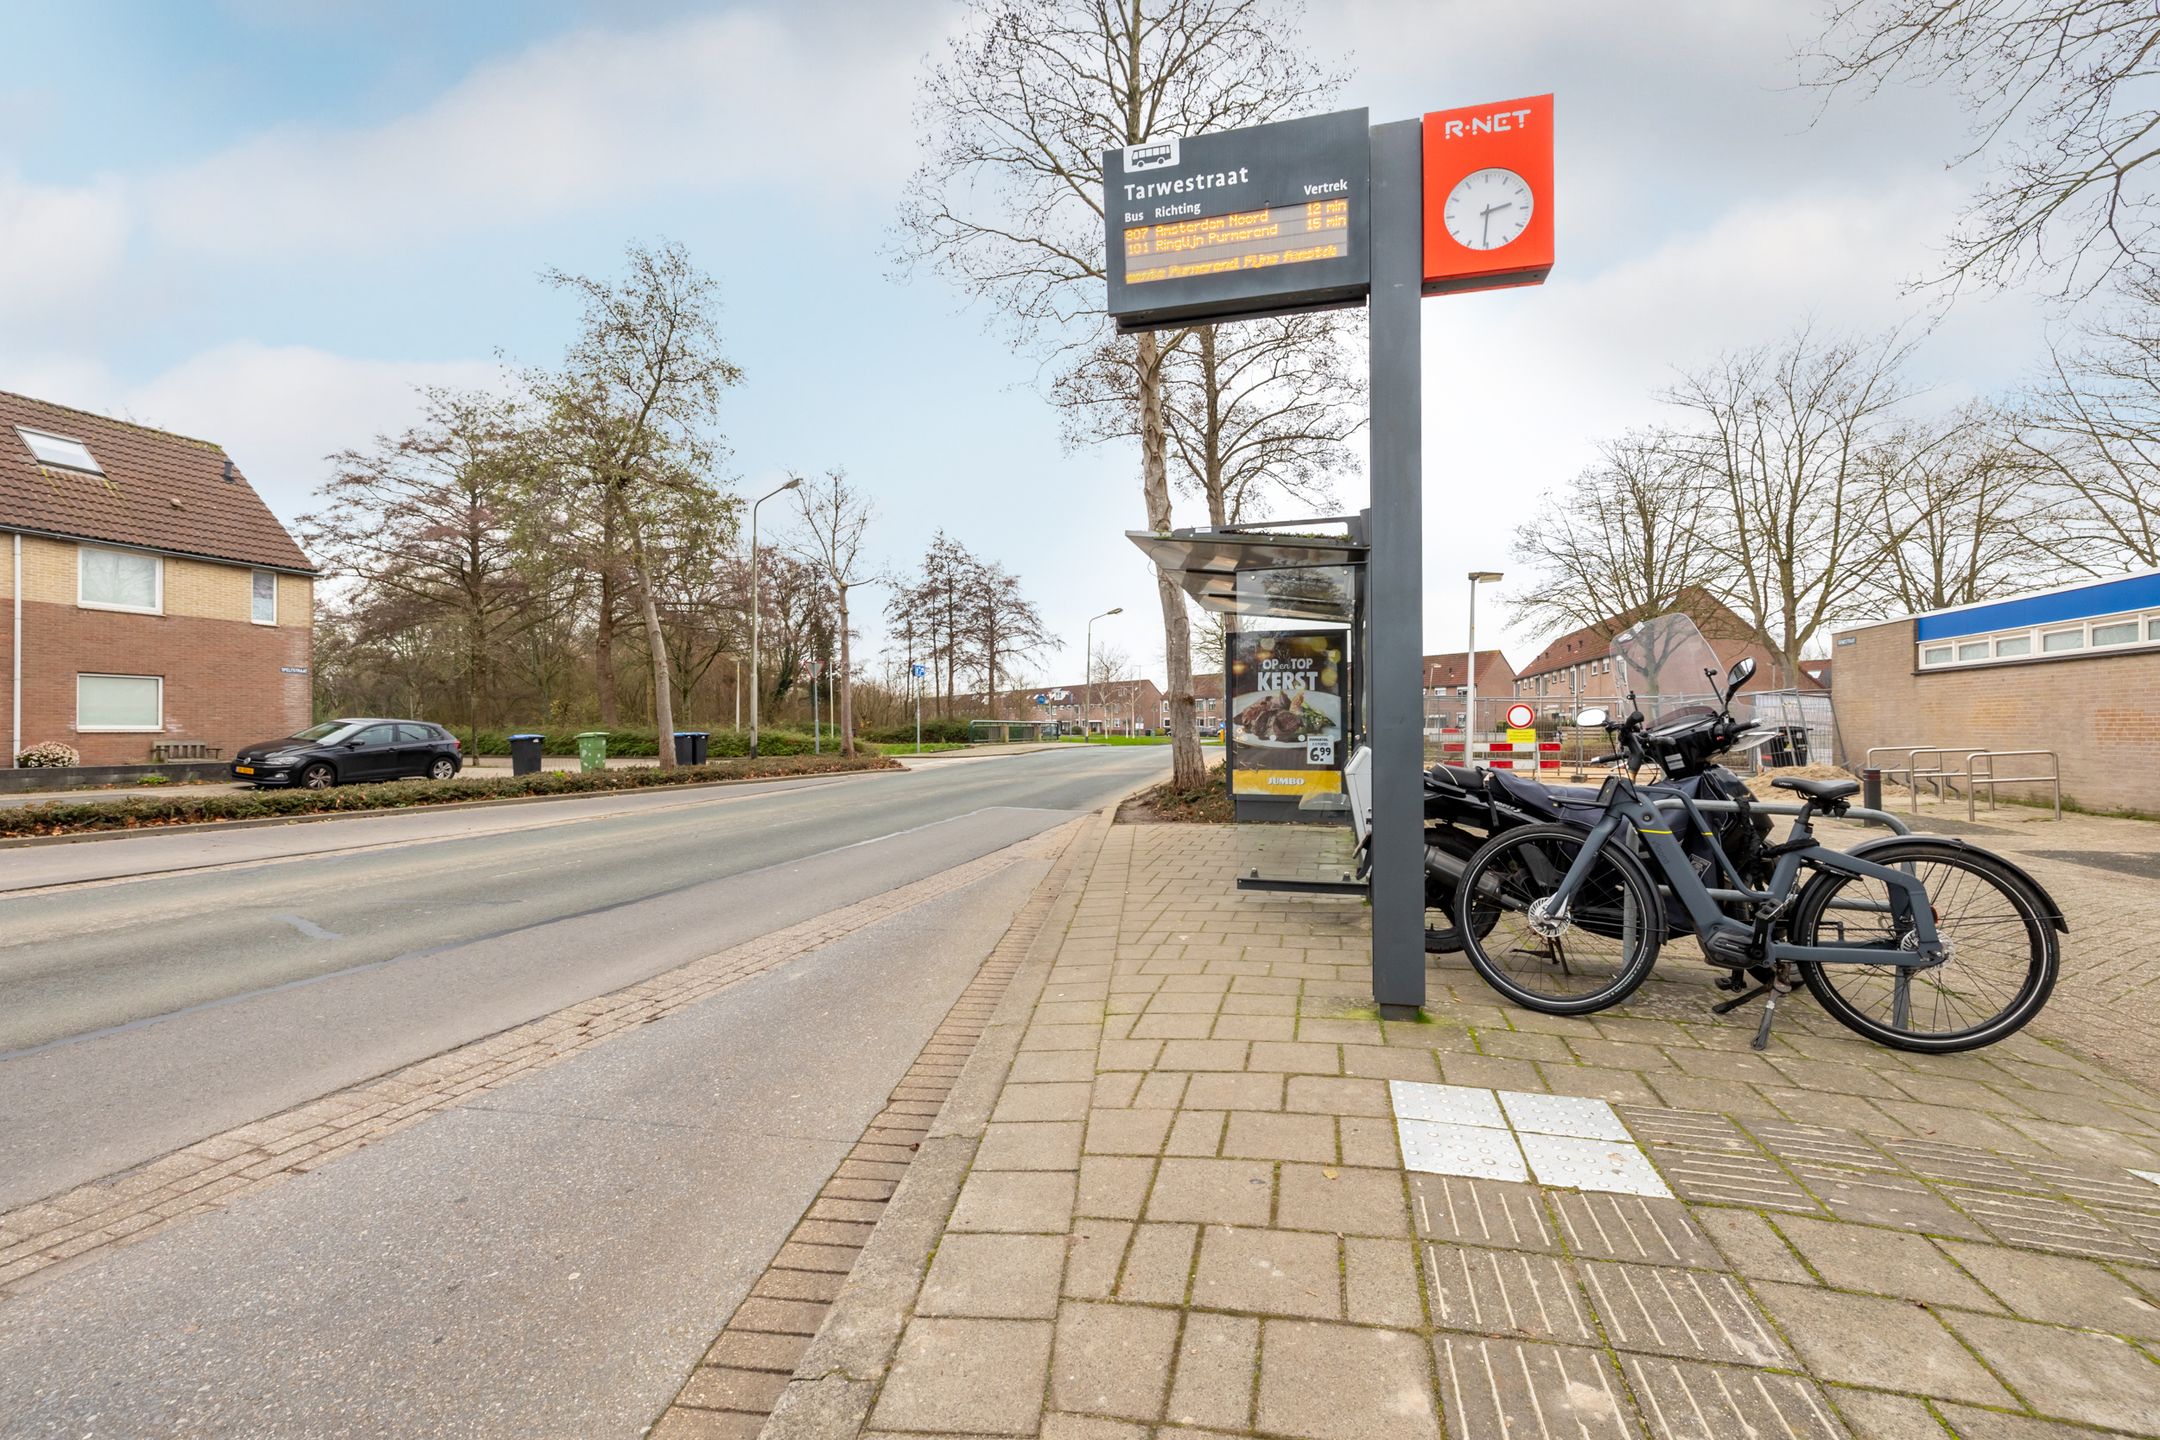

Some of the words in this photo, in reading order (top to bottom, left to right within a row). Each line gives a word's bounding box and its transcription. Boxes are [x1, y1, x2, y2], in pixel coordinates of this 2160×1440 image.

[1124, 167, 1249, 201] Tarwestraat
[1124, 211, 1144, 223] Bus
[1155, 203, 1201, 219] Richting
[1303, 178, 1348, 196] Vertrek
[1128, 241, 1149, 256] 101
[1155, 234, 1204, 252] Ringlijn
[1208, 223, 1279, 245] Purmerend
[1307, 216, 1322, 232] 15
[1326, 214, 1348, 230] min
[1155, 218, 1225, 238] Amsterdam
[1229, 209, 1269, 228] Noord
[1307, 201, 1322, 217] 12
[1326, 199, 1348, 214] min
[1257, 671, 1318, 691] KERST
[1262, 658, 1279, 670] OP
[1290, 658, 1313, 670] TOP
[1267, 777, 1305, 785] JUMBO
